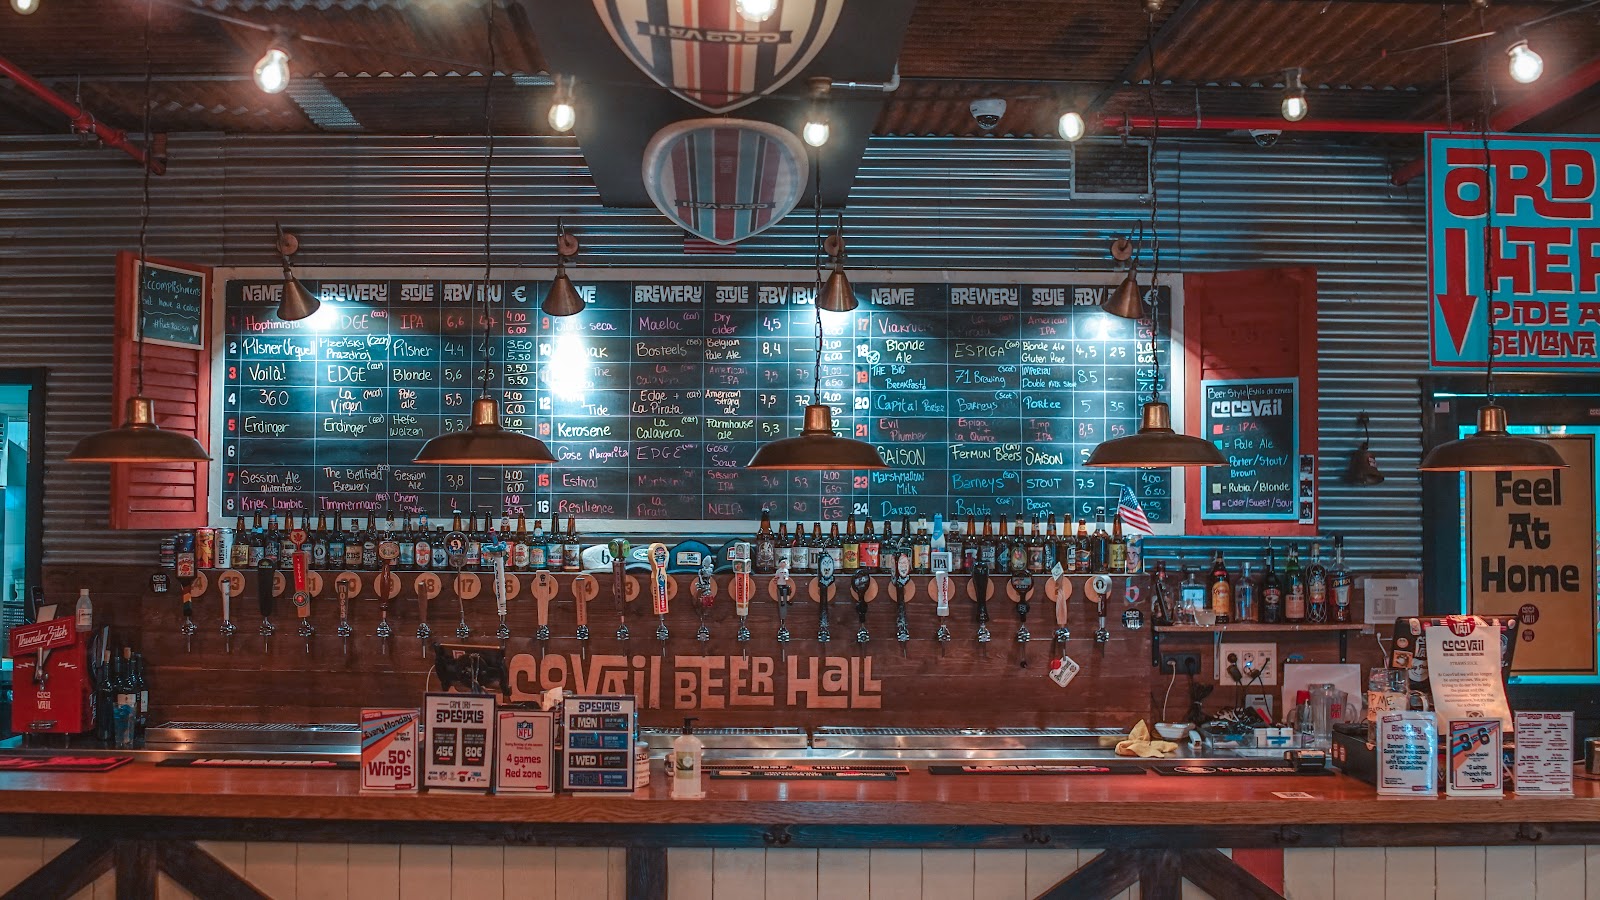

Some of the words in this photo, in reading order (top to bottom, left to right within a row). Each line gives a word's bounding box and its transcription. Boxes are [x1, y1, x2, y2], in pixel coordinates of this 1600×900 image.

[143, 280, 201, 297] ccomplishments
[443, 284, 473, 301] ABV
[758, 287, 789, 305] ABV
[400, 316, 424, 333] IPA
[542, 317, 550, 330] 9
[714, 312, 731, 326] Dry
[857, 318, 870, 333] 17
[229, 342, 237, 354] 2
[539, 343, 552, 356] 10
[635, 342, 687, 358] Bosteels
[856, 344, 869, 357] 18
[886, 339, 926, 355] Blonde
[954, 343, 1006, 359] ESPIGA
[895, 353, 913, 366] Ale
[228, 367, 237, 380] 3
[392, 369, 432, 386] Blonde
[857, 371, 868, 384] 19
[227, 393, 236, 406] 4
[1207, 386, 1227, 399] Beer
[540, 396, 551, 410] 12
[855, 396, 870, 410] 20
[227, 419, 235, 432] 5
[244, 415, 290, 437] Erdinger
[324, 416, 368, 437] Erdinger
[558, 422, 613, 437] Kerosene
[856, 423, 868, 437] 21
[227, 444, 235, 457] 6
[227, 472, 235, 485] 7
[538, 474, 550, 487] 15
[1230, 468, 1256, 479] Brown
[854, 476, 868, 490] 23
[1026, 477, 1063, 490] STOUT
[1494, 468, 1562, 508] Feel
[227, 500, 235, 512] 8
[537, 500, 550, 514] 16
[558, 499, 615, 515] Resilience
[854, 502, 869, 515] 24
[1508, 513, 1551, 551] At
[933, 559, 947, 569] IPA
[1480, 555, 1580, 593] Home
[460, 578, 475, 593] 17
[674, 655, 775, 709] BEER
[578, 701, 620, 713] SPECIALS
[435, 709, 484, 724] SPECIALS
[506, 754, 513, 764] 4
[514, 755, 542, 766] games
[575, 755, 597, 766] WED
[368, 761, 412, 781] Wings
[504, 768, 522, 778] Red
[522, 770, 542, 779] zone
